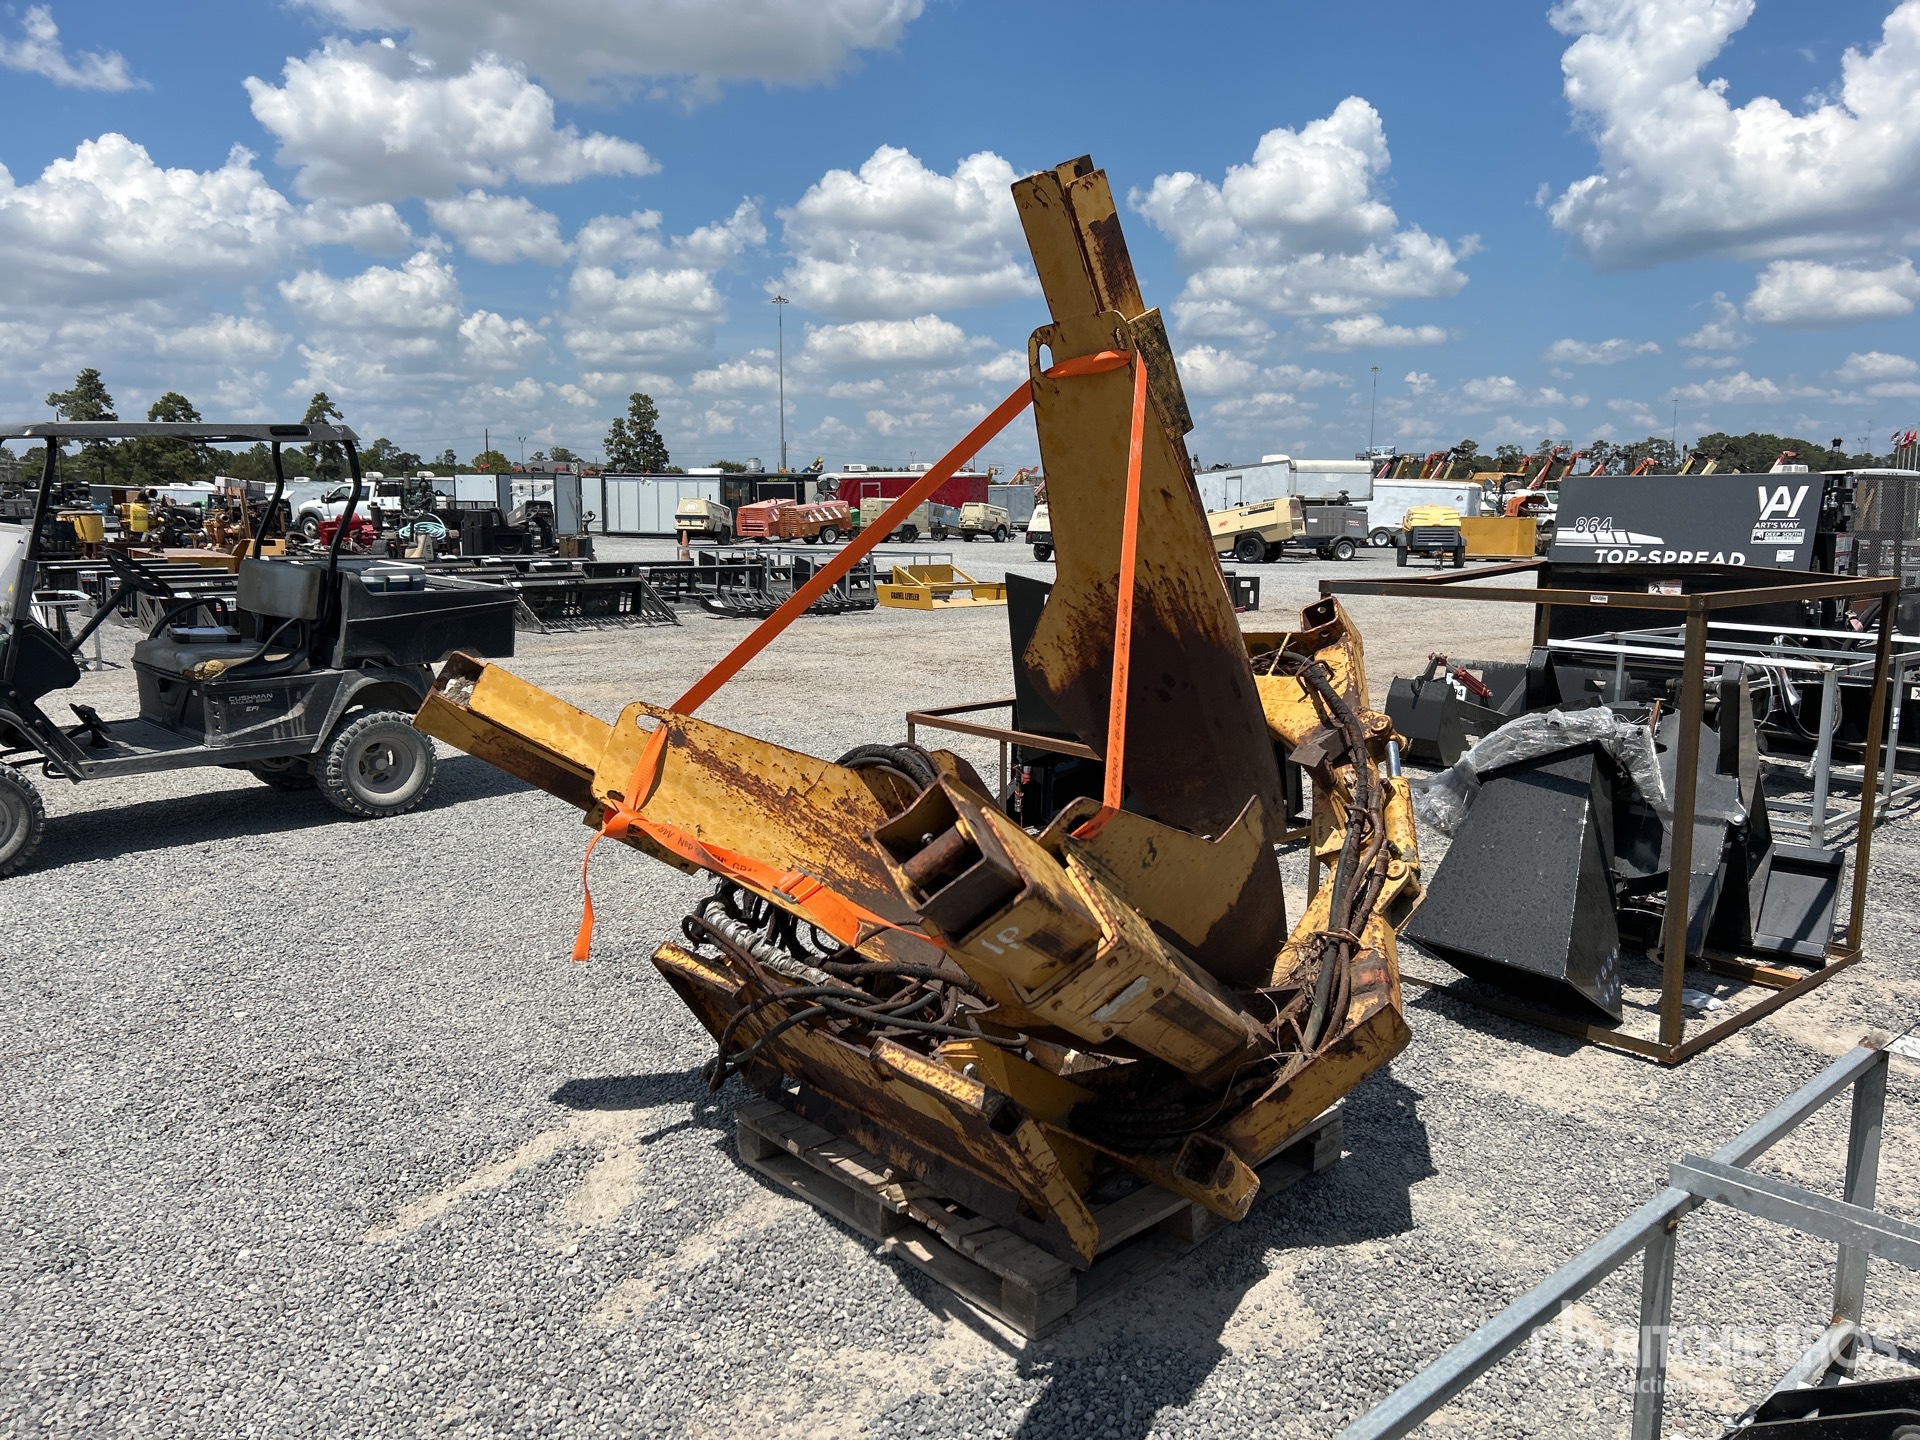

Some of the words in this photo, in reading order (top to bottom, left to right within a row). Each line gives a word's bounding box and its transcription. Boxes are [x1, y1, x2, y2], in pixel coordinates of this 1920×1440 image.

[1575, 517, 1612, 534] 864
[1594, 549, 1746, 566] TOP-SPREAD
[905, 592, 920, 601] LEVELER
[229, 693, 273, 701] CUSHMAN
